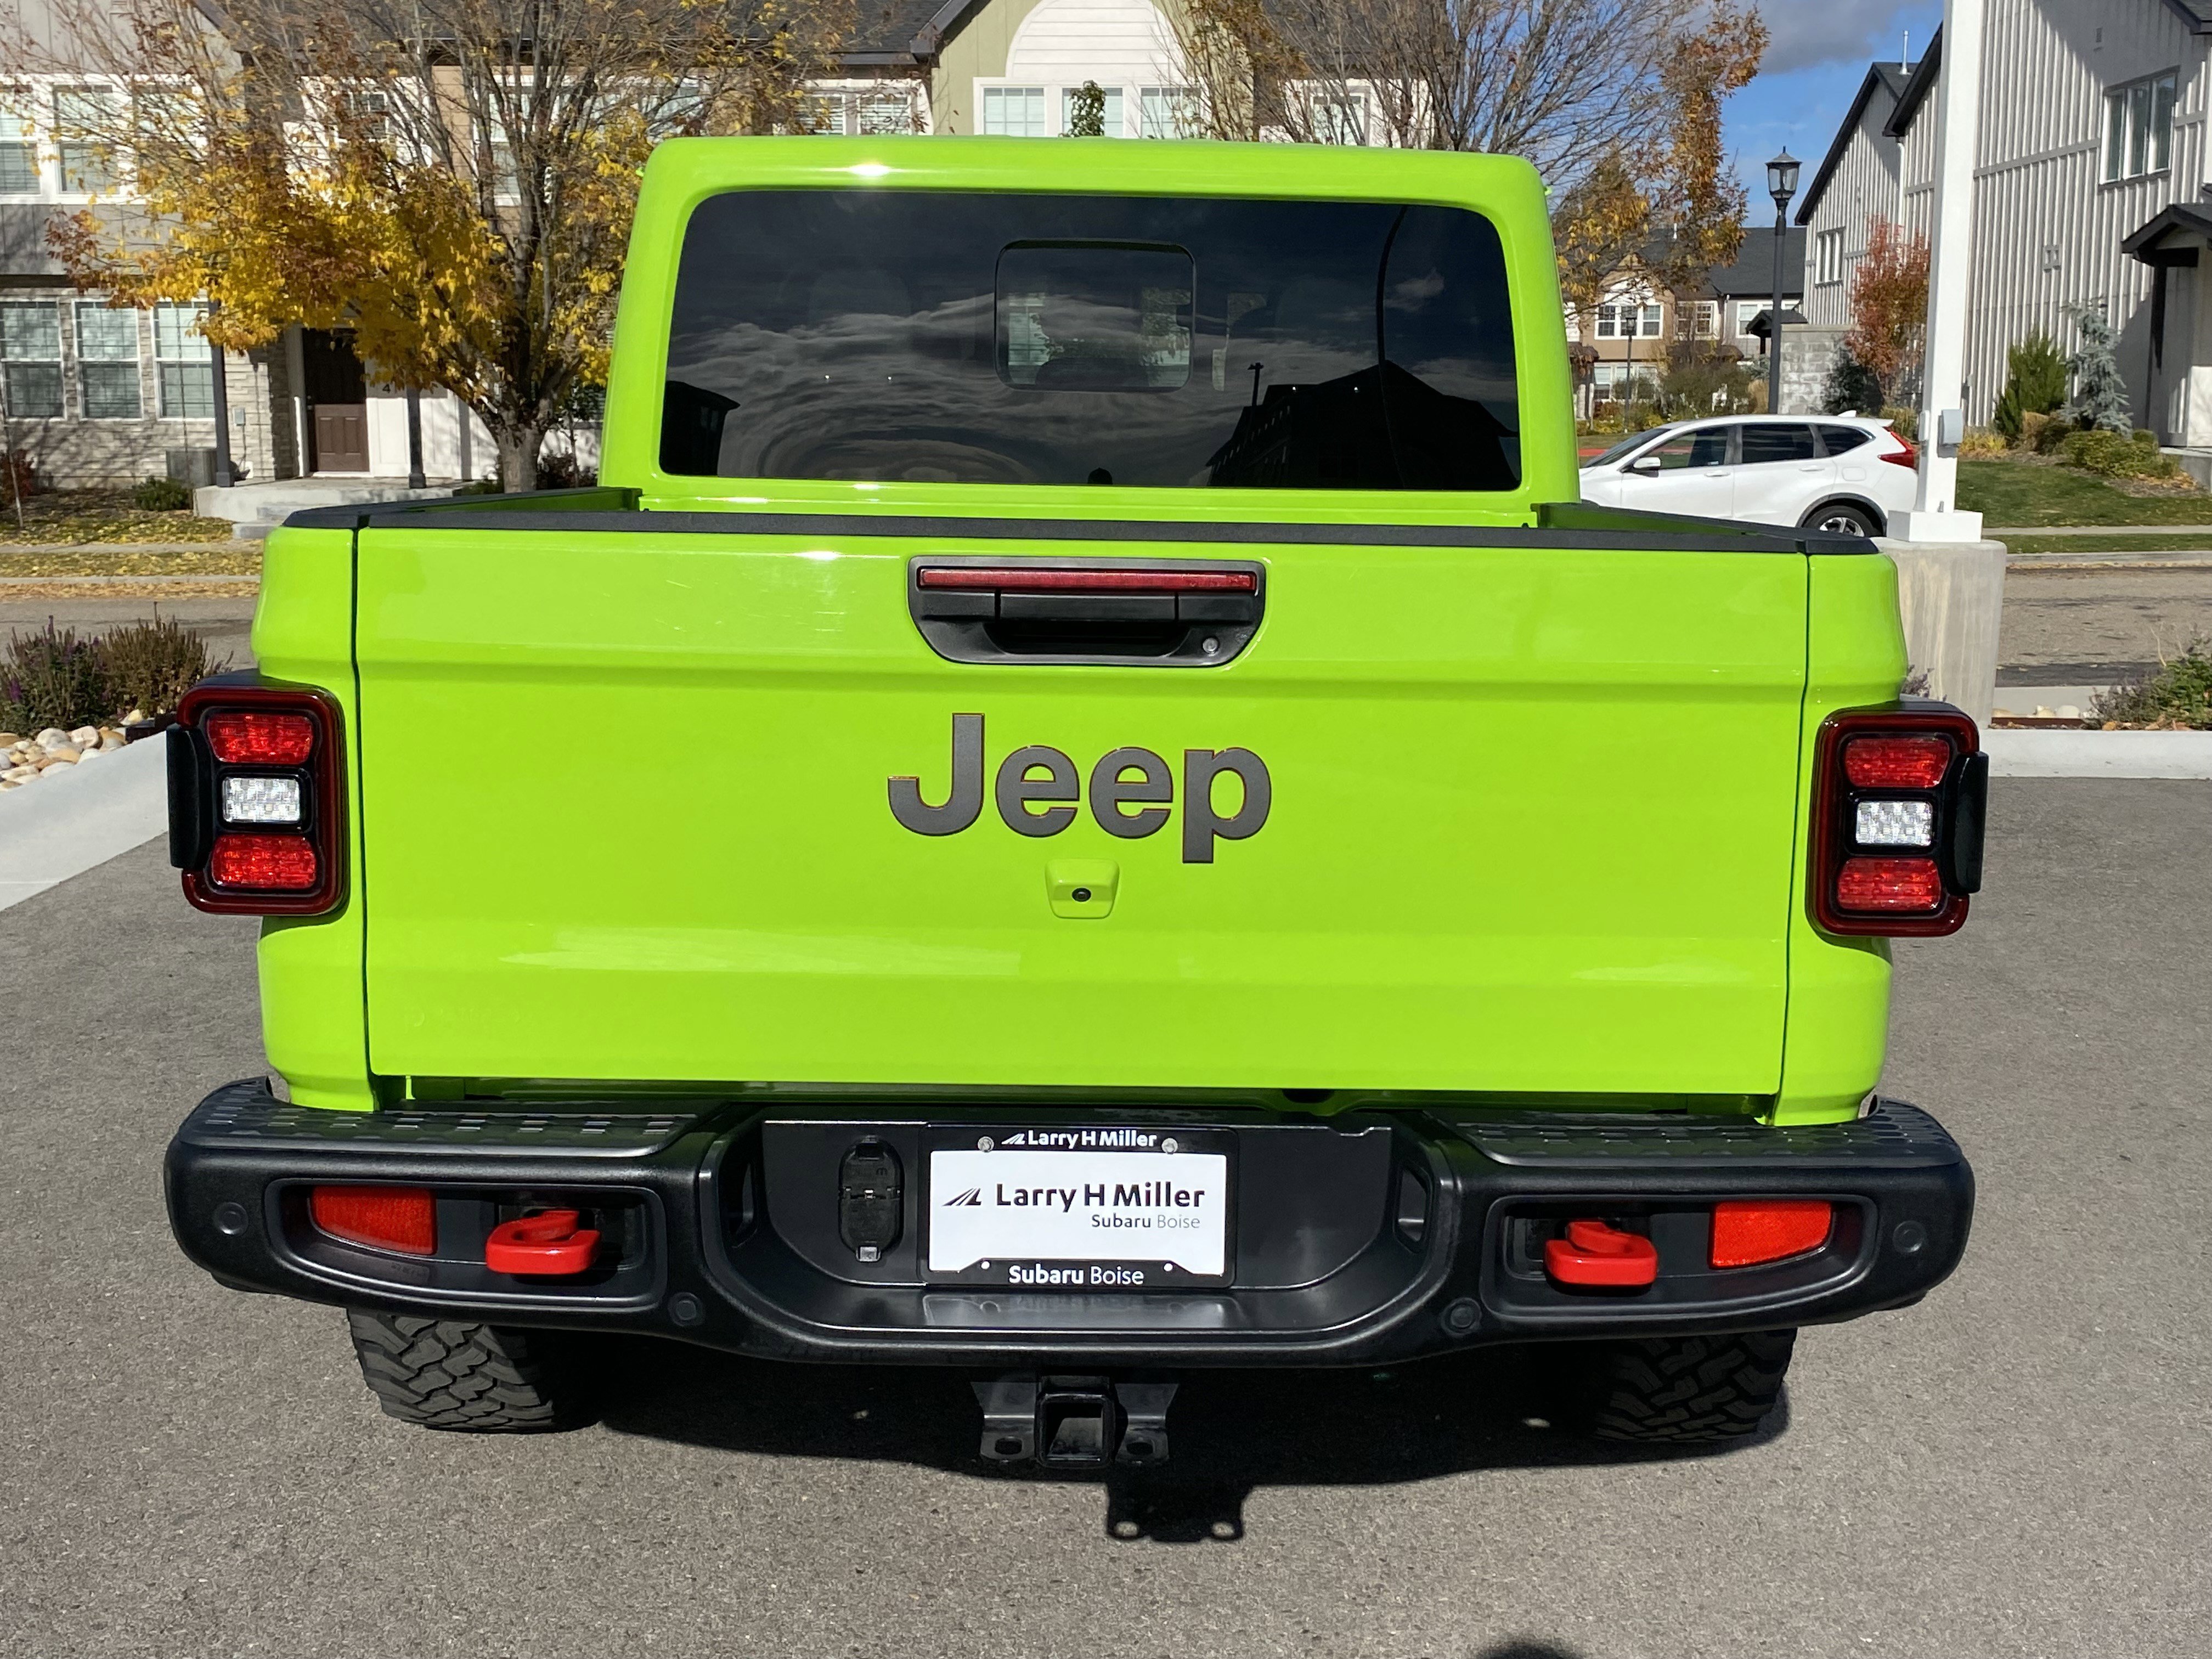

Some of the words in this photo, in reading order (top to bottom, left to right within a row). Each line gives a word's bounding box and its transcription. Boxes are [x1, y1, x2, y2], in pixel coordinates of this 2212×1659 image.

[888, 713, 1272, 864] Jeep
[1028, 1130, 1079, 1149] Larry
[1082, 1131, 1096, 1146] H
[1099, 1130, 1157, 1147] Miller
[996, 1183, 1077, 1212] Larry
[1084, 1183, 1104, 1206] H
[1113, 1181, 1205, 1207] Miller
[1091, 1213, 1151, 1228] Subaru
[1157, 1214, 1200, 1229] Boise
[1008, 1263, 1084, 1284] Subaru
[1090, 1266, 1144, 1285] Boise
